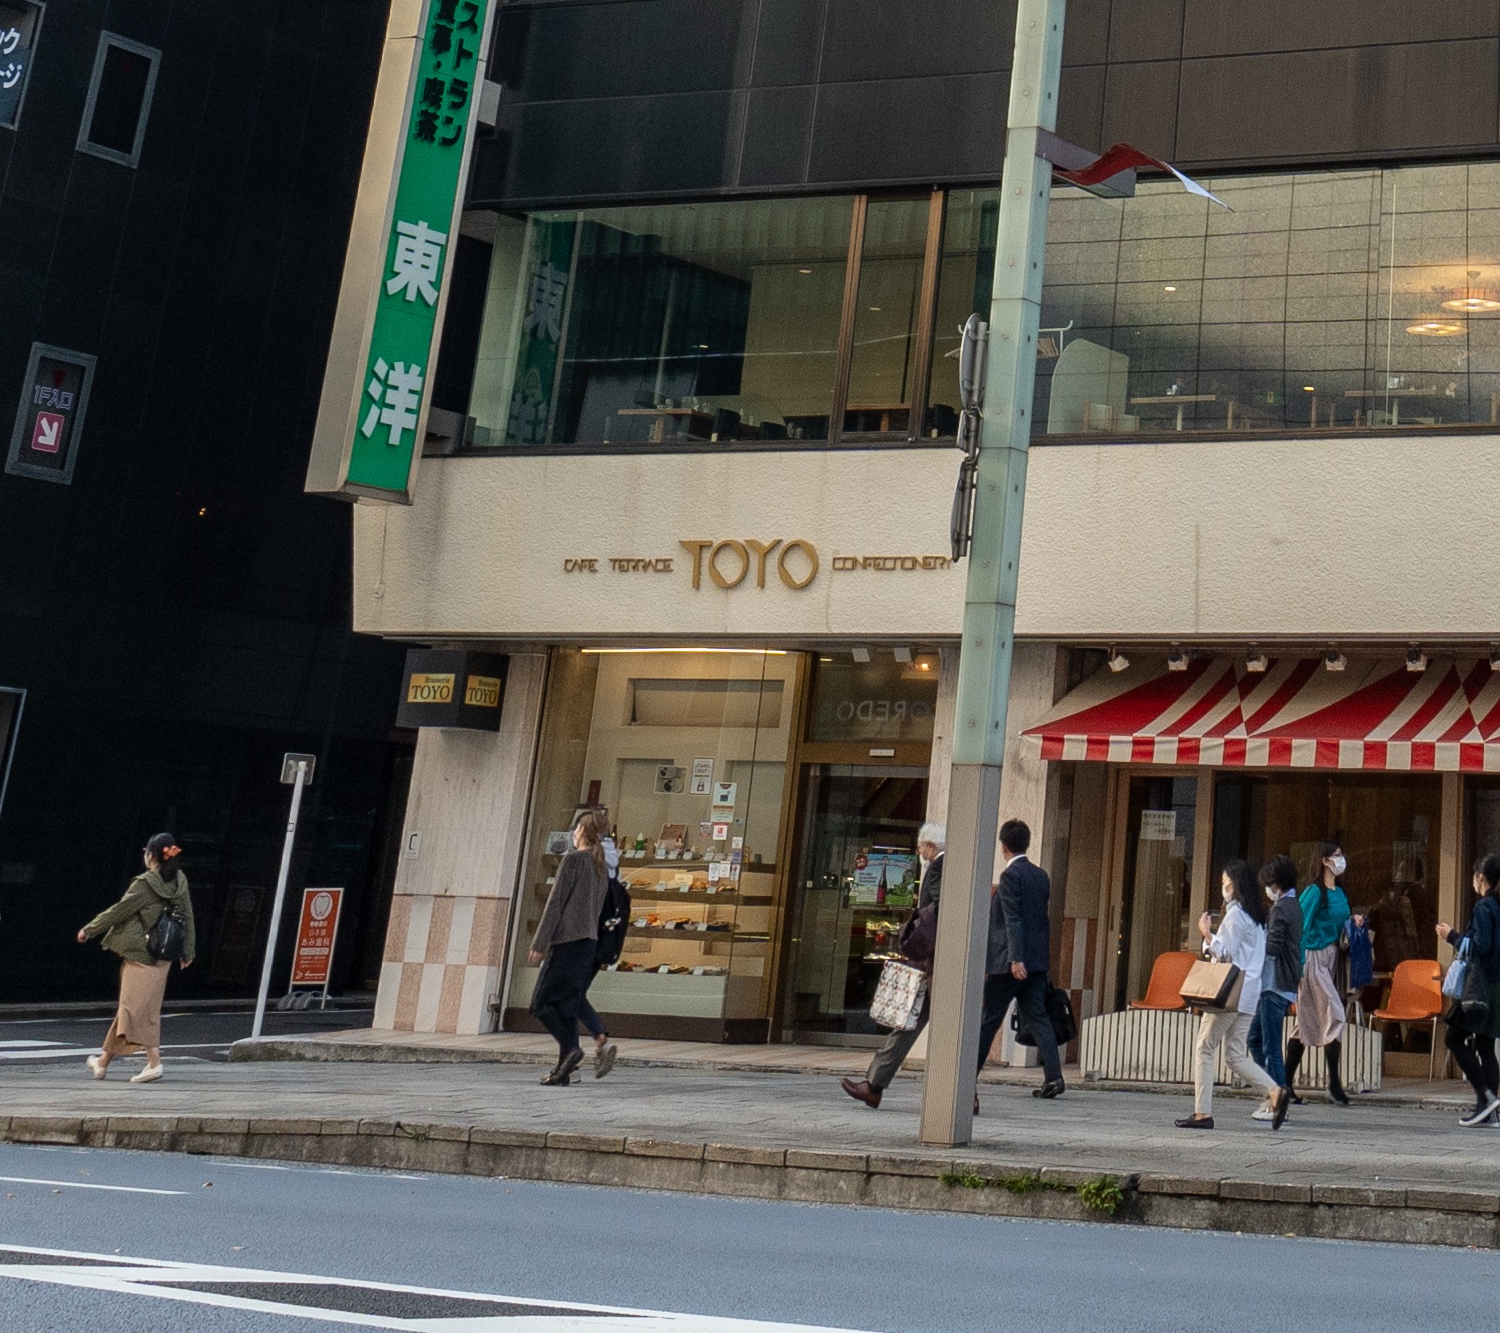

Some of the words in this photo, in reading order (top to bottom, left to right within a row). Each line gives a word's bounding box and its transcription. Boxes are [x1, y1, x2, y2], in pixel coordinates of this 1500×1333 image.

[362, 220, 447, 446] 東洋
[33, 384, 74, 410] 1F入口
[563, 558, 599, 573] CAFE
[608, 557, 675, 573] TERRACE
[678, 538, 820, 590] TOYO
[831, 555, 956, 571] CONFECTIONERY
[411, 685, 451, 700] TOYO
[468, 687, 498, 705] TOYO
